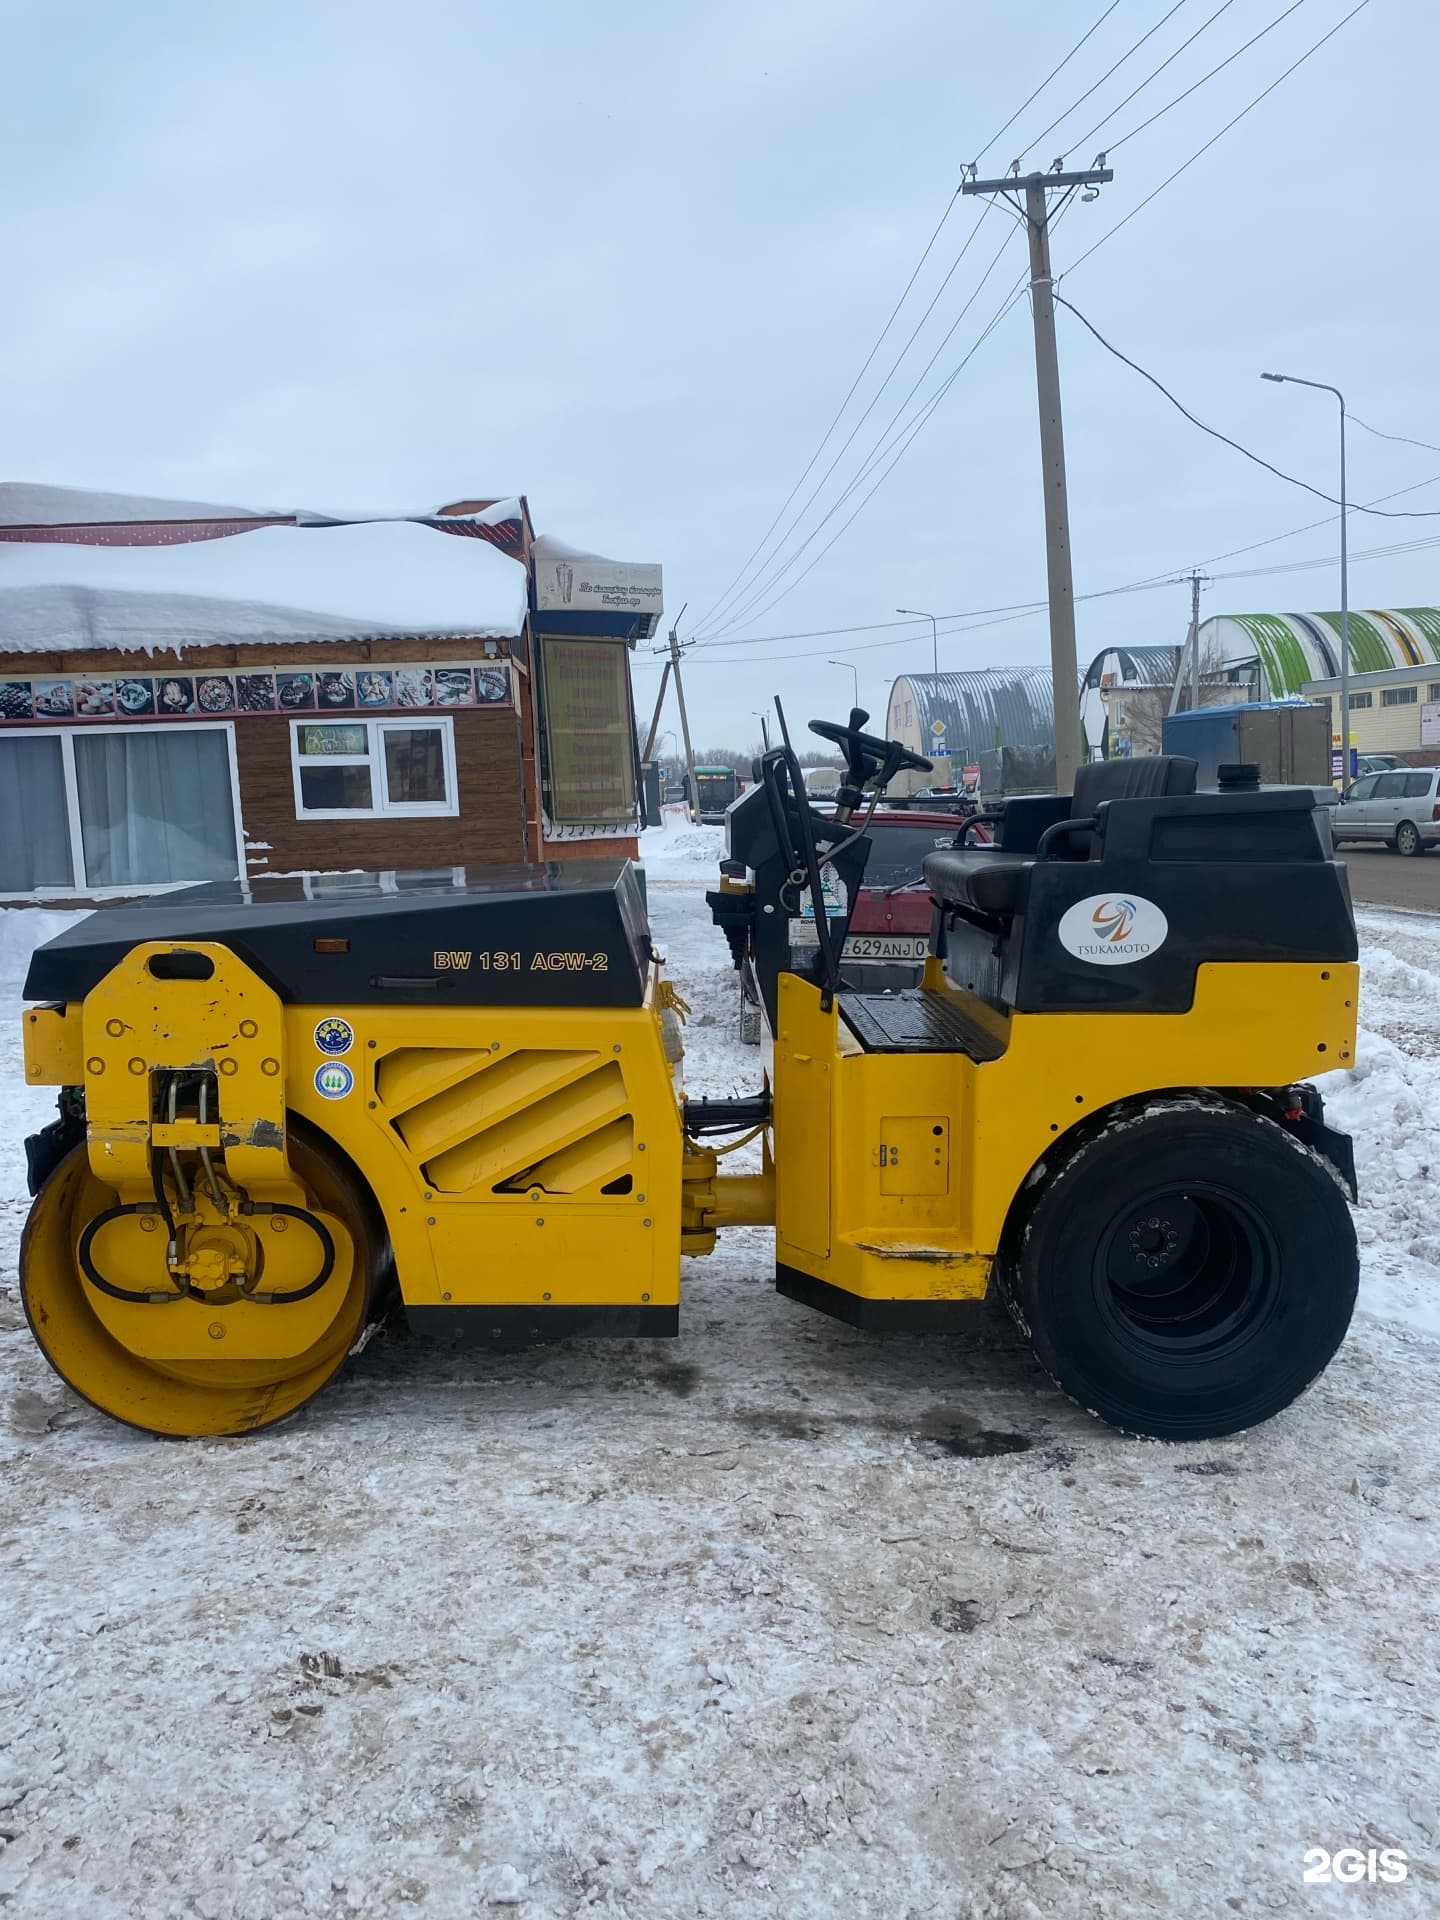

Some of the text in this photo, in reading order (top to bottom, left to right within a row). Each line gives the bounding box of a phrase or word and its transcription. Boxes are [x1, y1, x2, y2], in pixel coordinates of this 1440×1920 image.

[1078, 944, 1150, 955] TSUKAMOTO
[434, 952, 609, 971] BW 131 ACW-2
